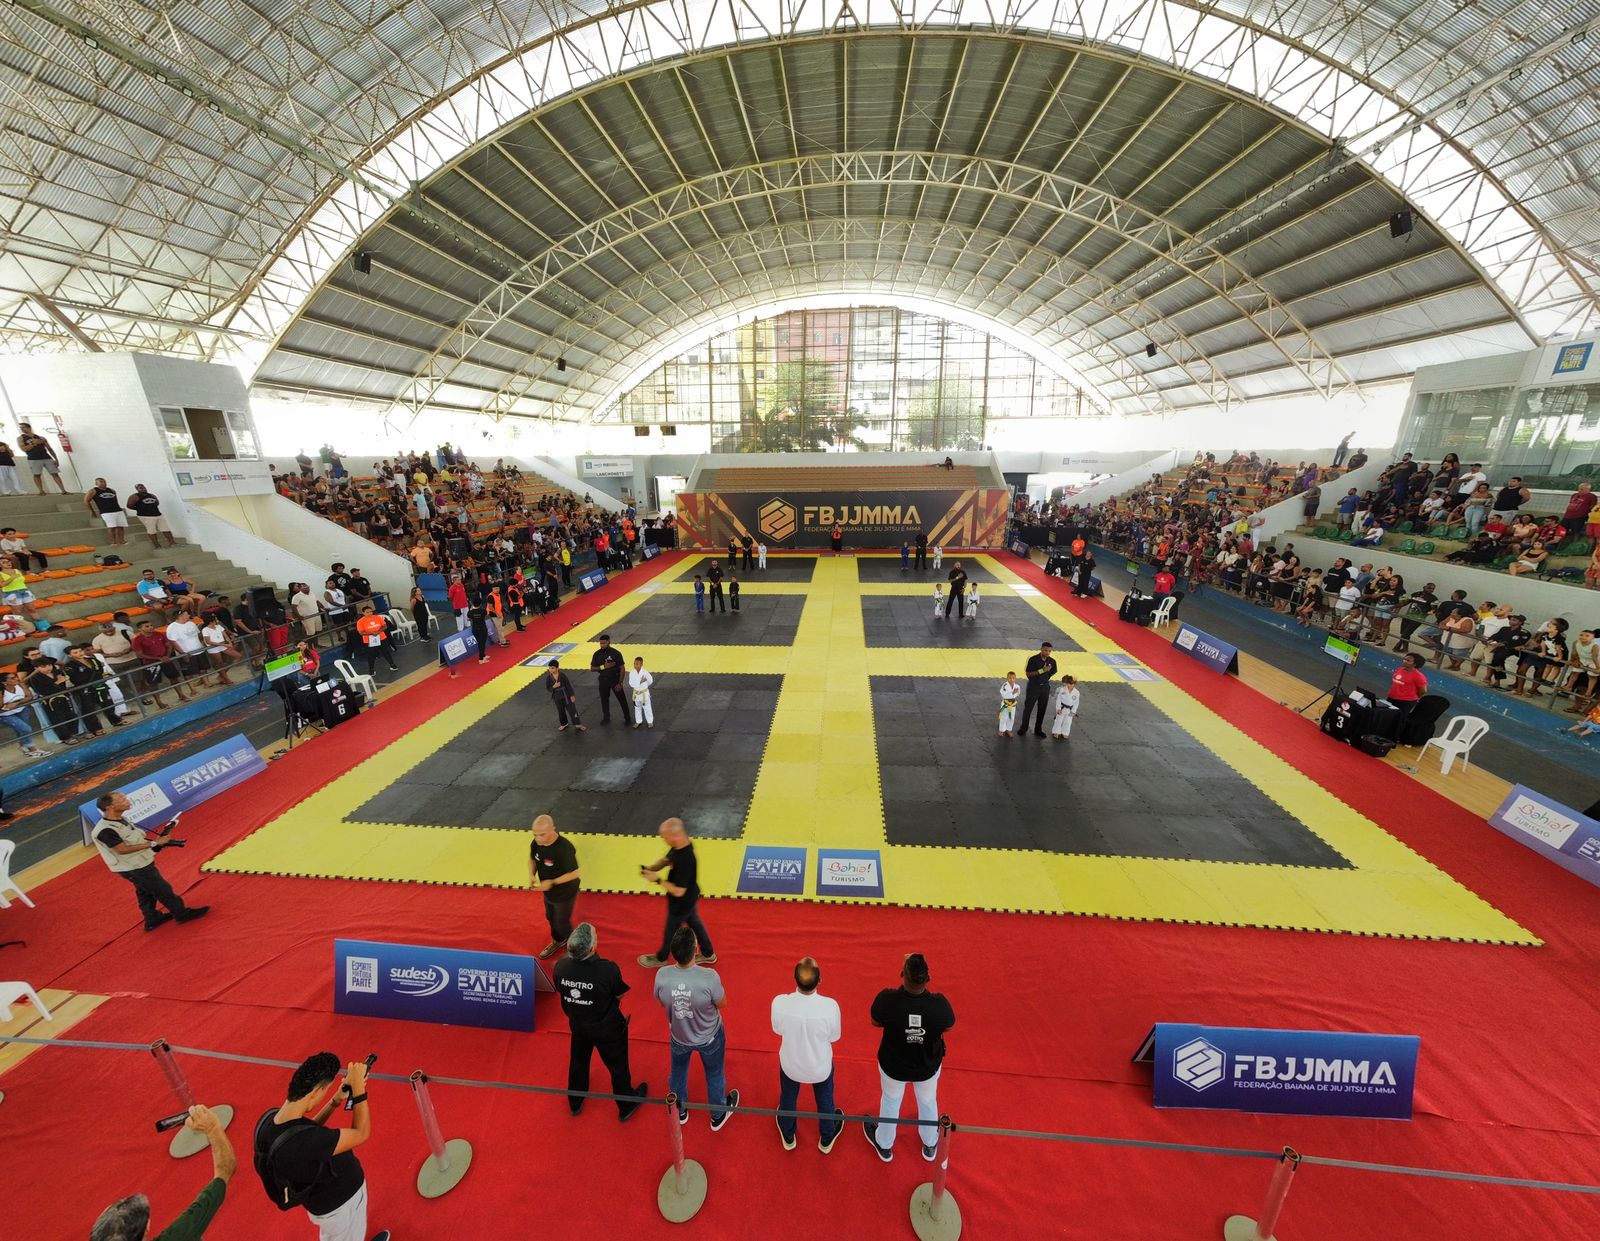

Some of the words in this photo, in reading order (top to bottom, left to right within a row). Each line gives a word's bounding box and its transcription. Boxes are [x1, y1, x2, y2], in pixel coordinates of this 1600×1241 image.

[803, 505, 922, 525] FBJJMMA
[338, 703, 346, 715] 6
[1336, 716, 1344, 728] 3
[1518, 804, 1571, 832] Bahia!
[1514, 816, 1550, 838] TURISMO
[827, 861, 872, 873] Bahia!
[390, 967, 436, 981] sudesb
[459, 968, 488, 976] GOVERNO
[352, 977, 372, 988] PARTE
[1234, 1055, 1396, 1085] FBJJMMA
[1234, 1081, 1283, 1090] FEDERAÇÃO
[1285, 1083, 1315, 1091] BAIANA
[1344, 1085, 1367, 1093] JITSU
